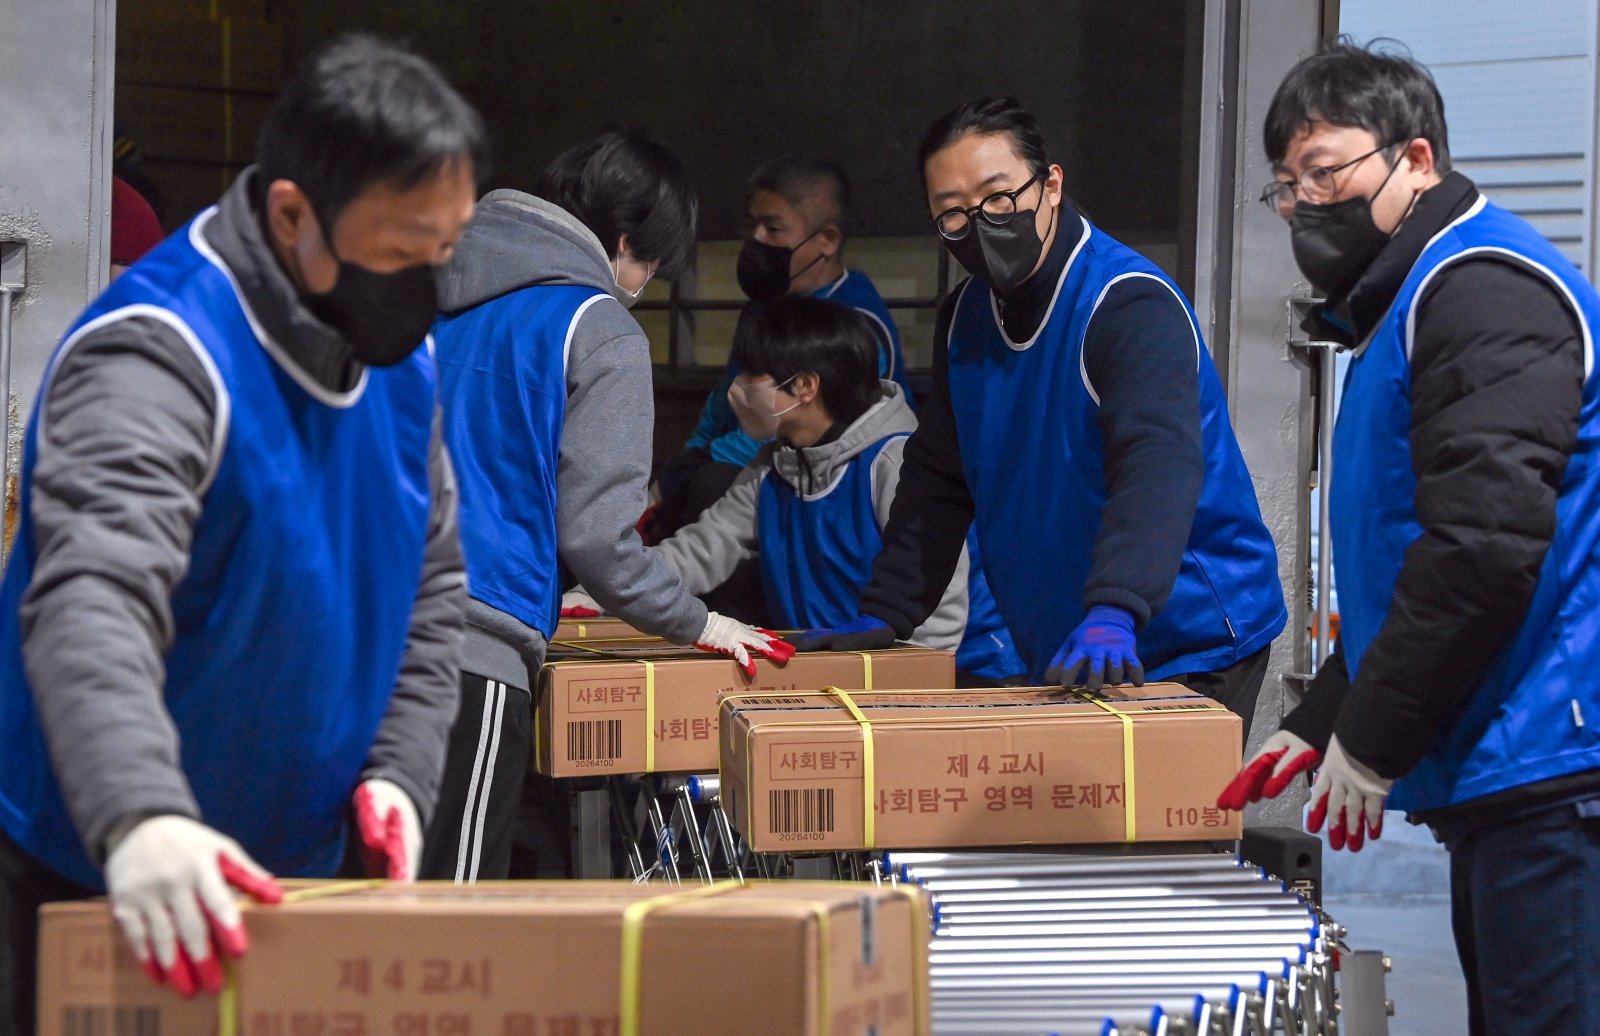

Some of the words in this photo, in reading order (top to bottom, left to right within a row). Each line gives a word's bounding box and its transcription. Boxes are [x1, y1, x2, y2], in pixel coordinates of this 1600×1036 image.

[577, 686, 641, 704] 사회탐구
[575, 760, 614, 768] 20264100
[779, 751, 858, 771] 사회탐구
[946, 753, 969, 778] 제
[976, 754, 991, 775] 4
[999, 751, 1045, 776] 교시
[983, 785, 1034, 812] 영역
[1050, 782, 1126, 809] 문제지
[779, 832, 825, 841] 20264100
[337, 957, 372, 997] 제
[382, 957, 405, 991] 4
[419, 957, 493, 998] 교시
